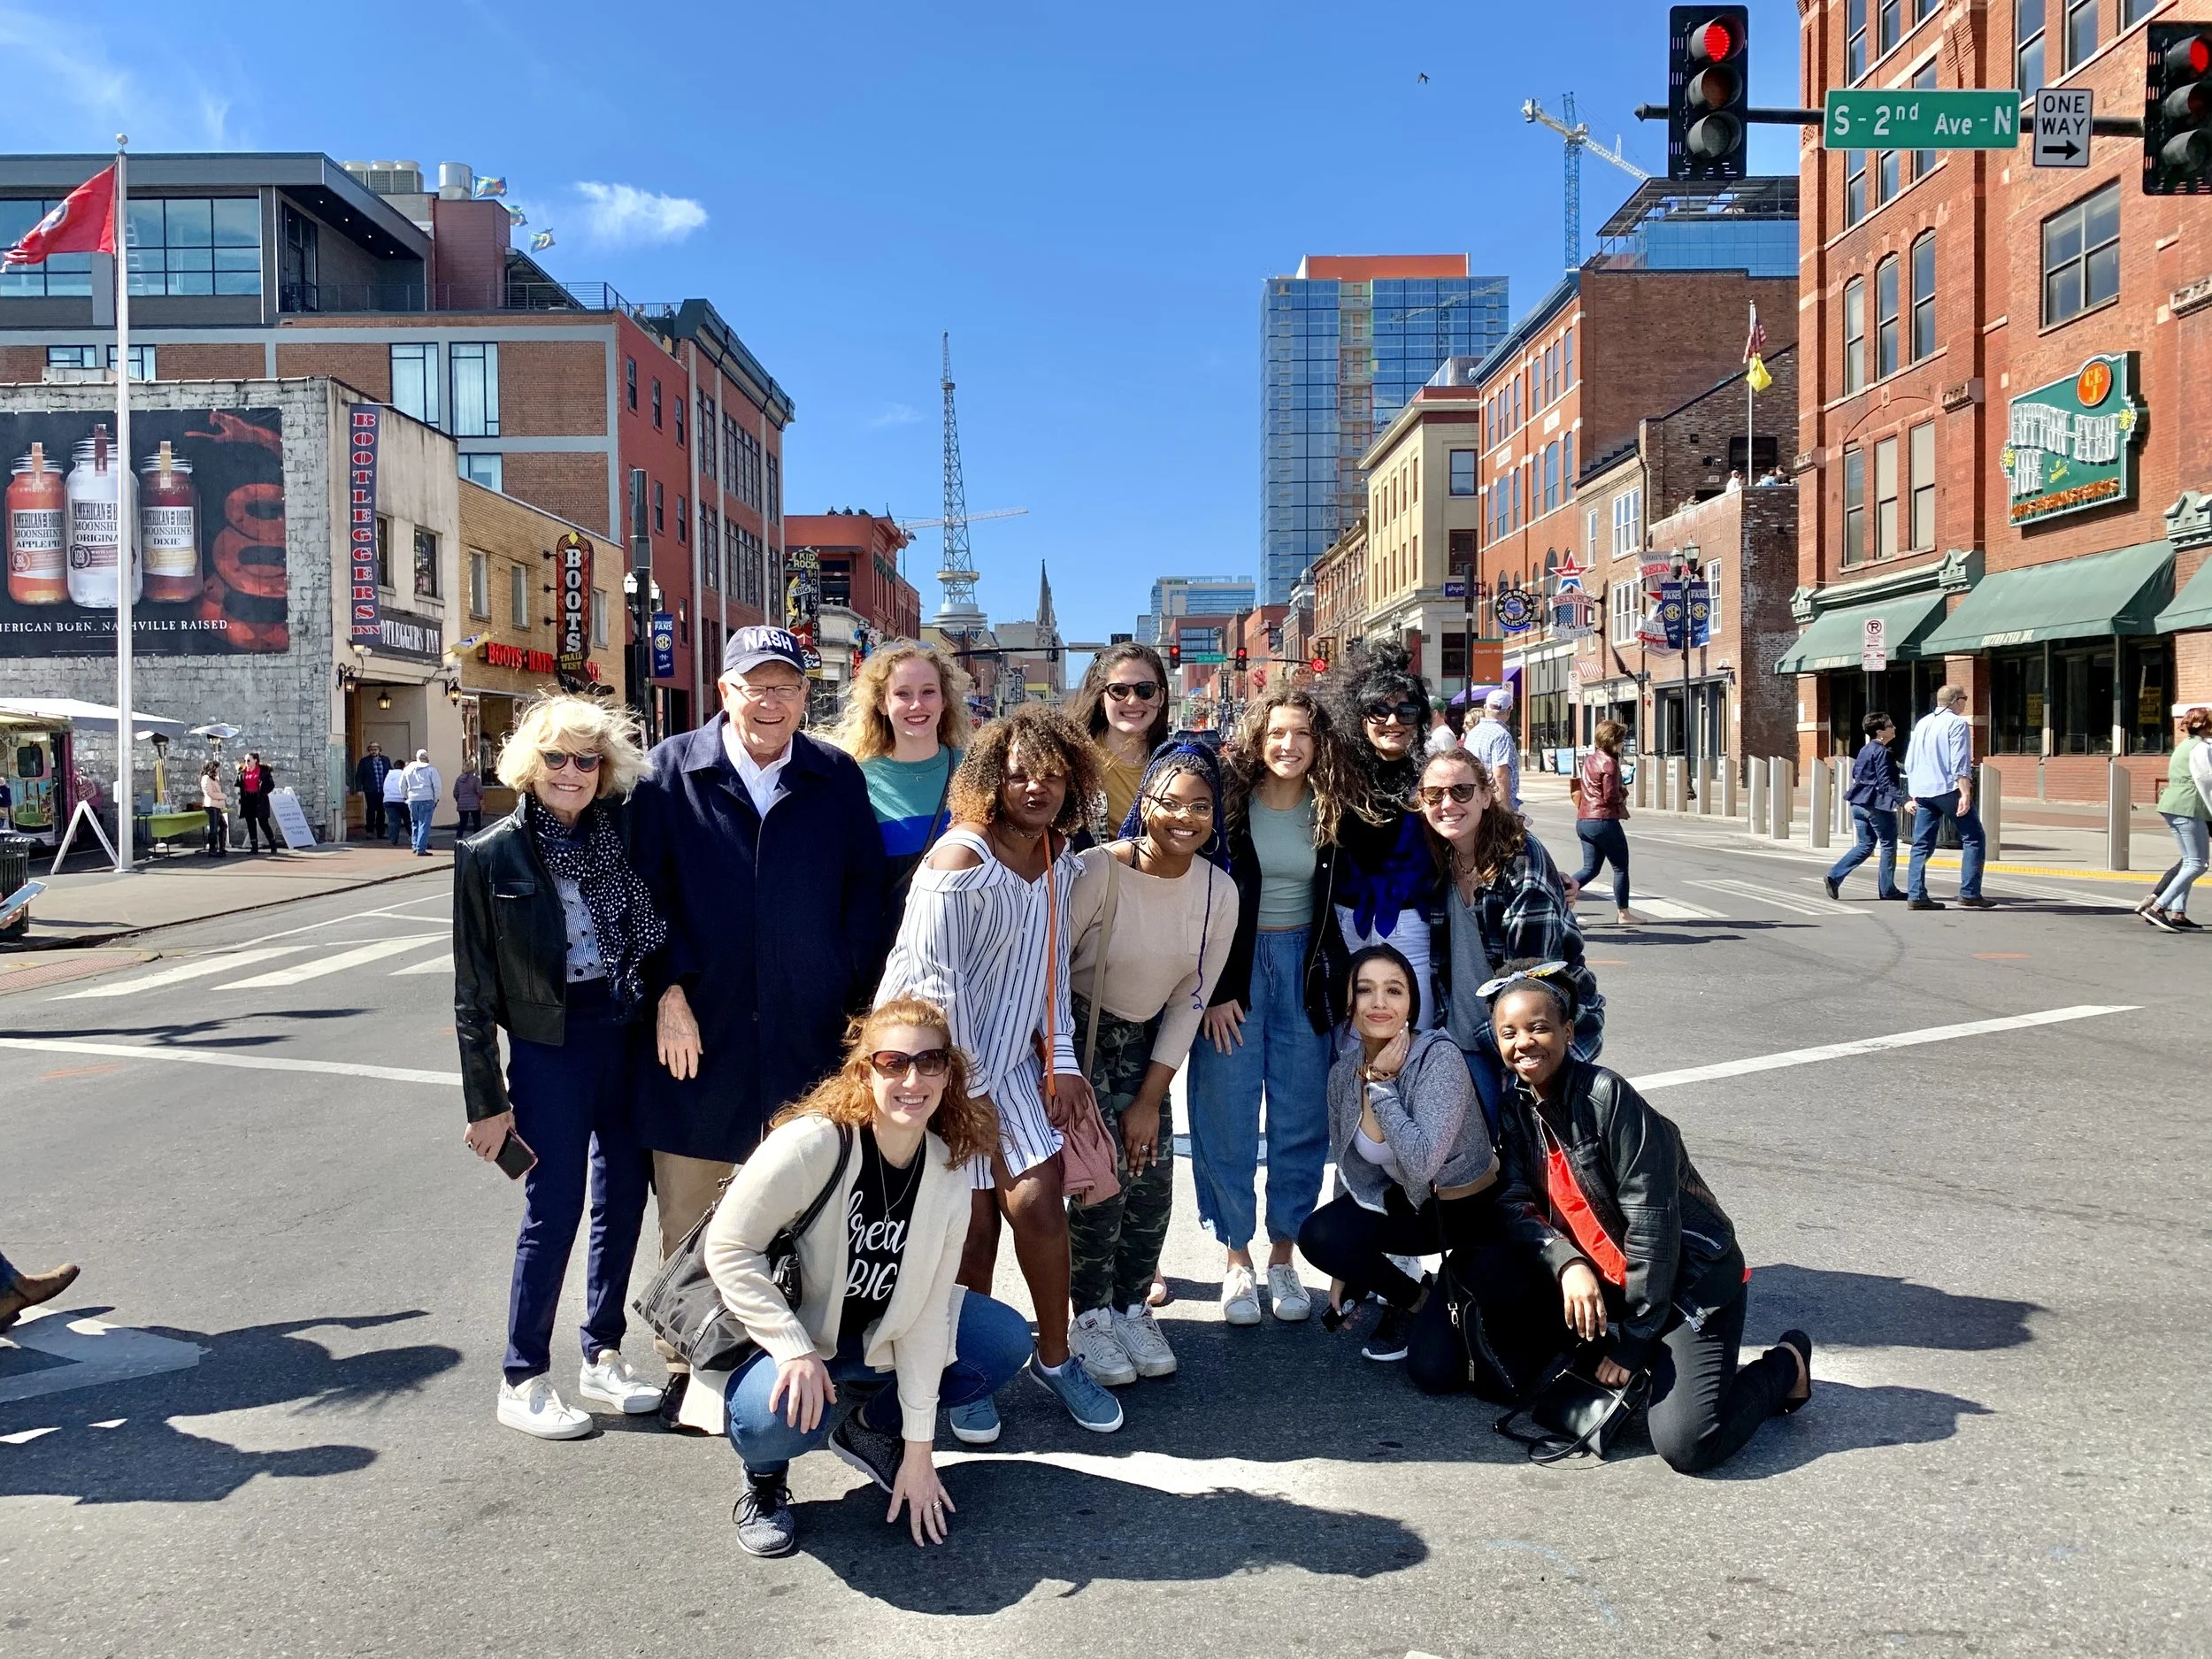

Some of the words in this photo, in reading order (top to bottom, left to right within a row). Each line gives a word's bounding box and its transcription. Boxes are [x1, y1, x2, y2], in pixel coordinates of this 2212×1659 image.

[2043, 95, 2085, 113] ONE
[2041, 117, 2088, 135] WAY
[74, 503, 105, 520] AMERICAN
[142, 511, 169, 526] AMERICAN
[177, 511, 192, 526] BORN
[351, 413, 377, 619] BOOTLEGGERS
[14, 512, 42, 528] AMERICAN
[74, 521, 118, 531] MOONSHI
[142, 526, 192, 535] MOONSHINE
[76, 534, 118, 542] ORIGINA
[799, 552, 816, 561] KID
[1641, 562, 1690, 578] REDNK
[796, 586, 810, 595] BIG
[1501, 592, 1512, 601] THE
[1513, 590, 1530, 602] NASH
[565, 548, 582, 653] BOOTS
[1553, 594, 1594, 607] REDNECK
[1666, 605, 1680, 618] SEC
[1694, 604, 1708, 618] SEC
[57, 622, 96, 632] BORN.
[102, 620, 176, 632] NAHVILLE
[180, 619, 233, 630] RAISED.
[1498, 611, 1532, 626] COLLECTION
[351, 625, 380, 635] INN
[381, 619, 423, 652] OTLEGGERS
[426, 628, 440, 655] INN
[657, 635, 669, 649] SEC
[743, 629, 794, 653] NASH
[488, 641, 523, 669] BOOTS
[527, 649, 554, 673] HATS
[559, 650, 583, 662] TRAIL
[561, 661, 582, 671] WEST
[843, 1258, 898, 1301] BIG
